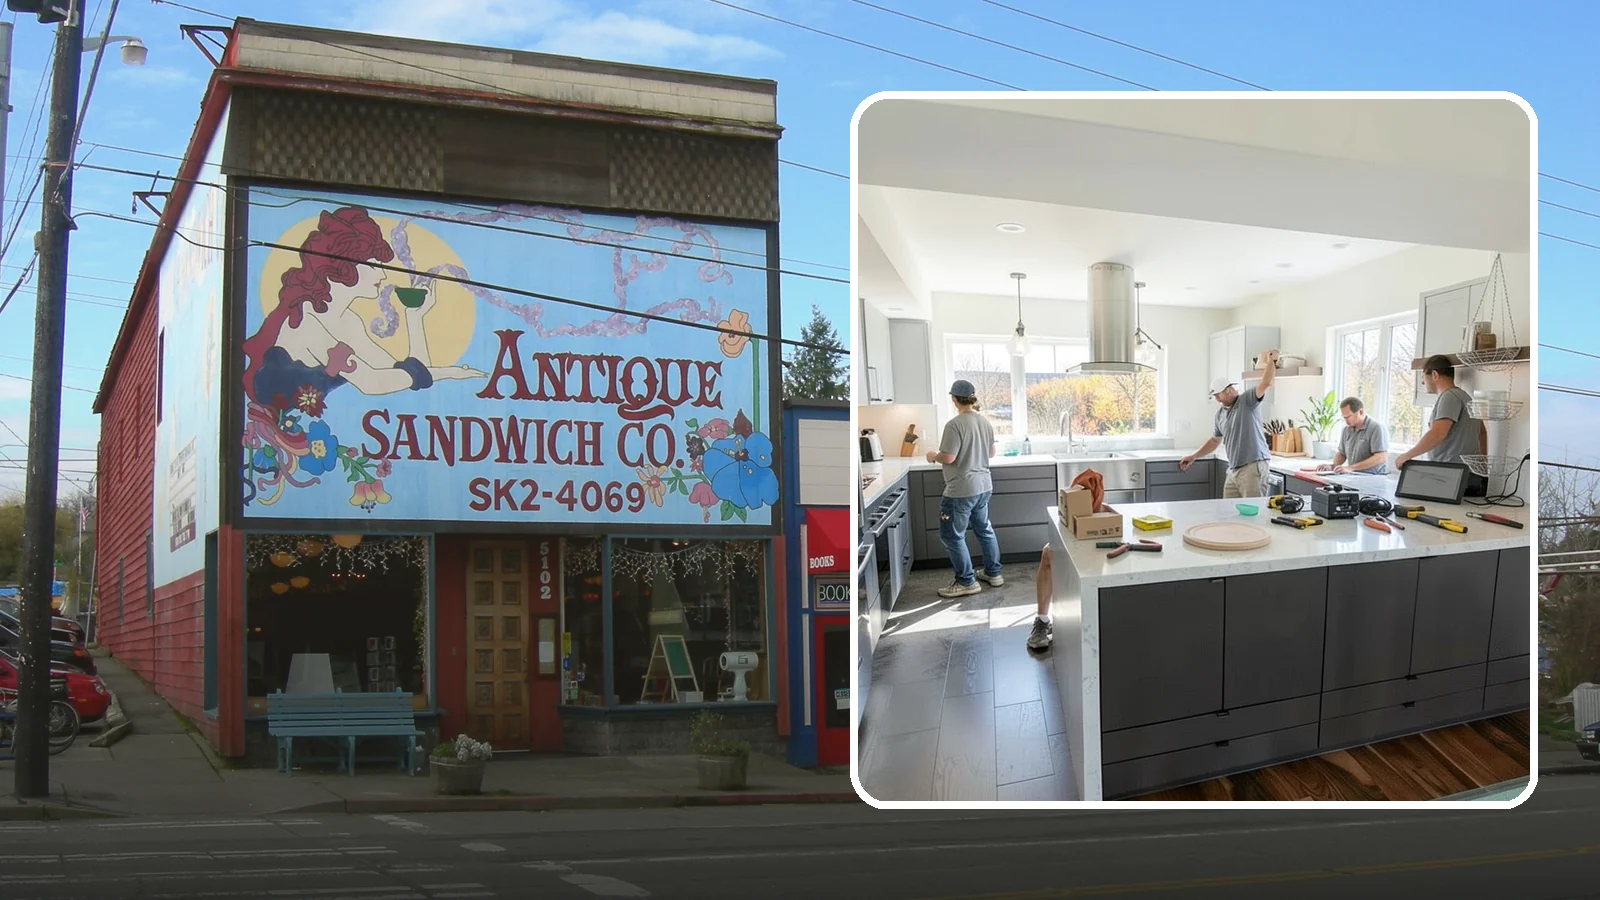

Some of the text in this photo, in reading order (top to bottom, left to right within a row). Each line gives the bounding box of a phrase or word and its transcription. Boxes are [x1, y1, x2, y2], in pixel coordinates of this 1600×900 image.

[475, 328, 724, 421] ANTIQUE
[360, 408, 686, 470] SANDWICH CO.
[467, 476, 646, 514] SK2-4069
[539, 541, 552, 600] 5102
[809, 554, 835, 569] BOOKS
